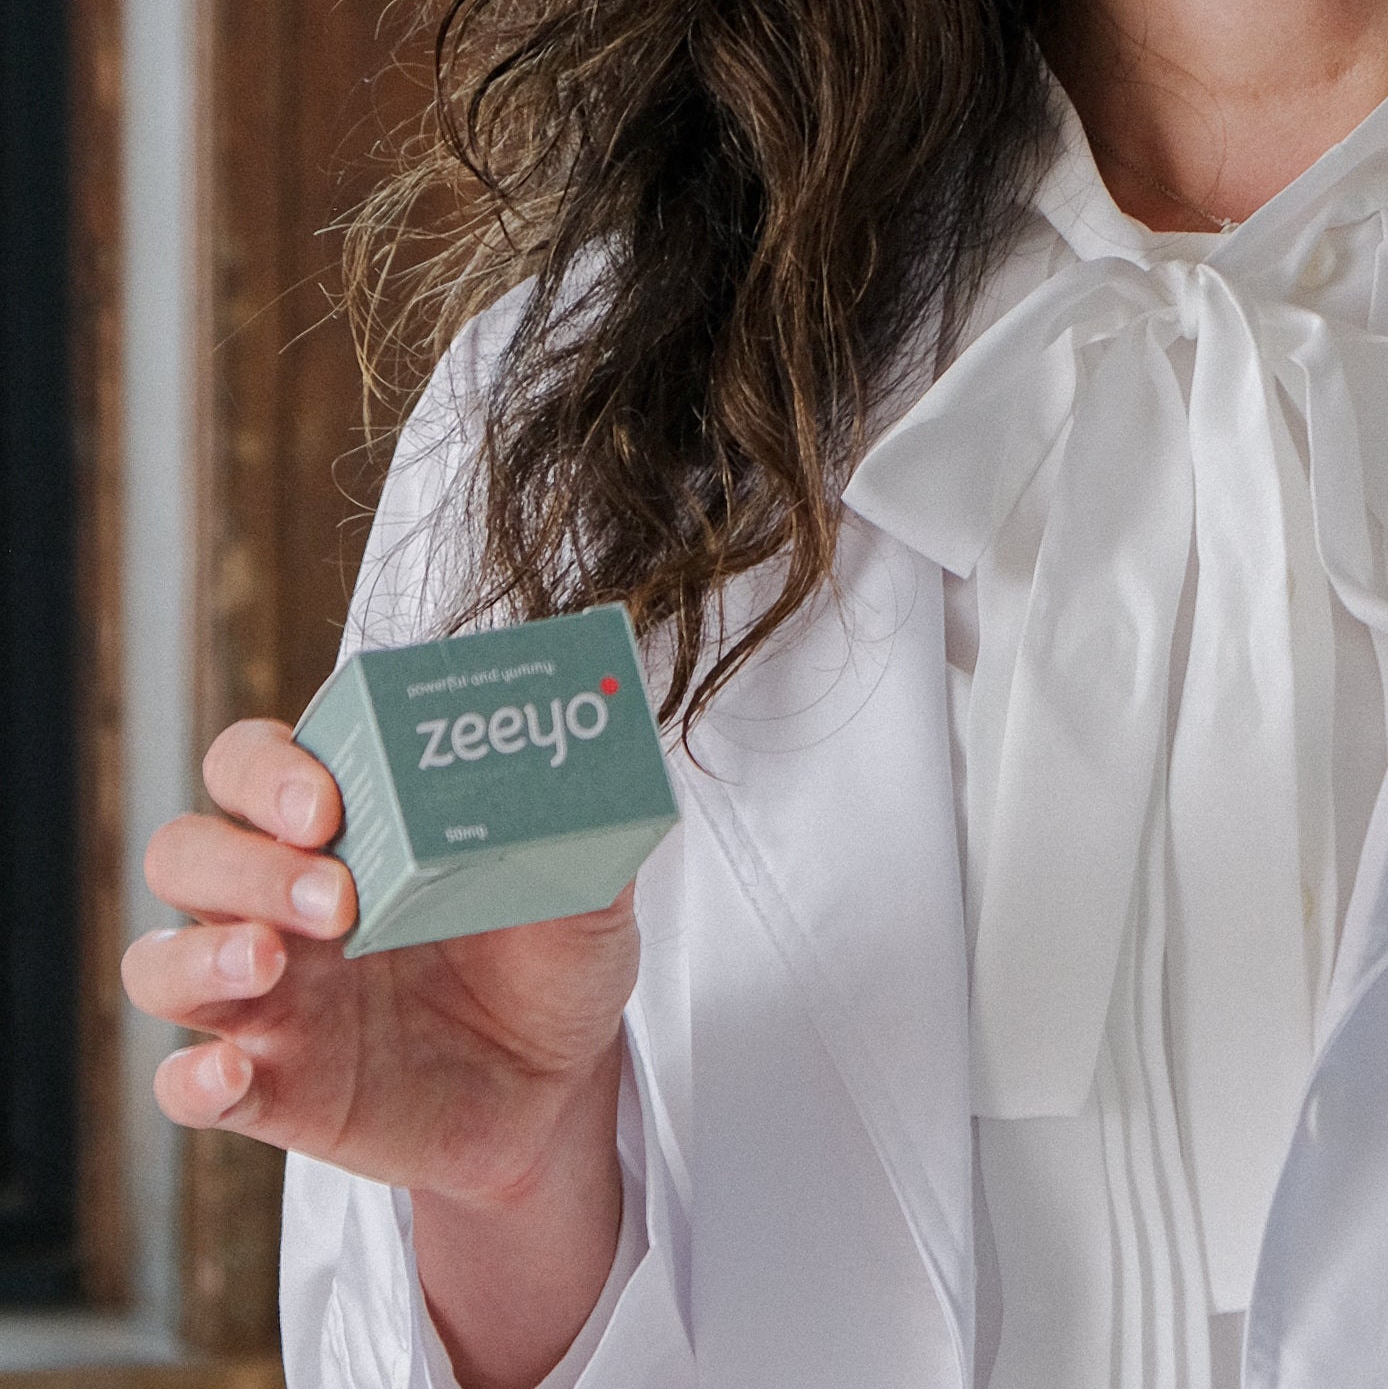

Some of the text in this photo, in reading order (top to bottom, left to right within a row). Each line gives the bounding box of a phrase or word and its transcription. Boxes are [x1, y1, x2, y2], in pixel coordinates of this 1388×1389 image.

[406, 674, 468, 700] powerful
[470, 668, 499, 687] and
[415, 691, 609, 770] zeeyo
